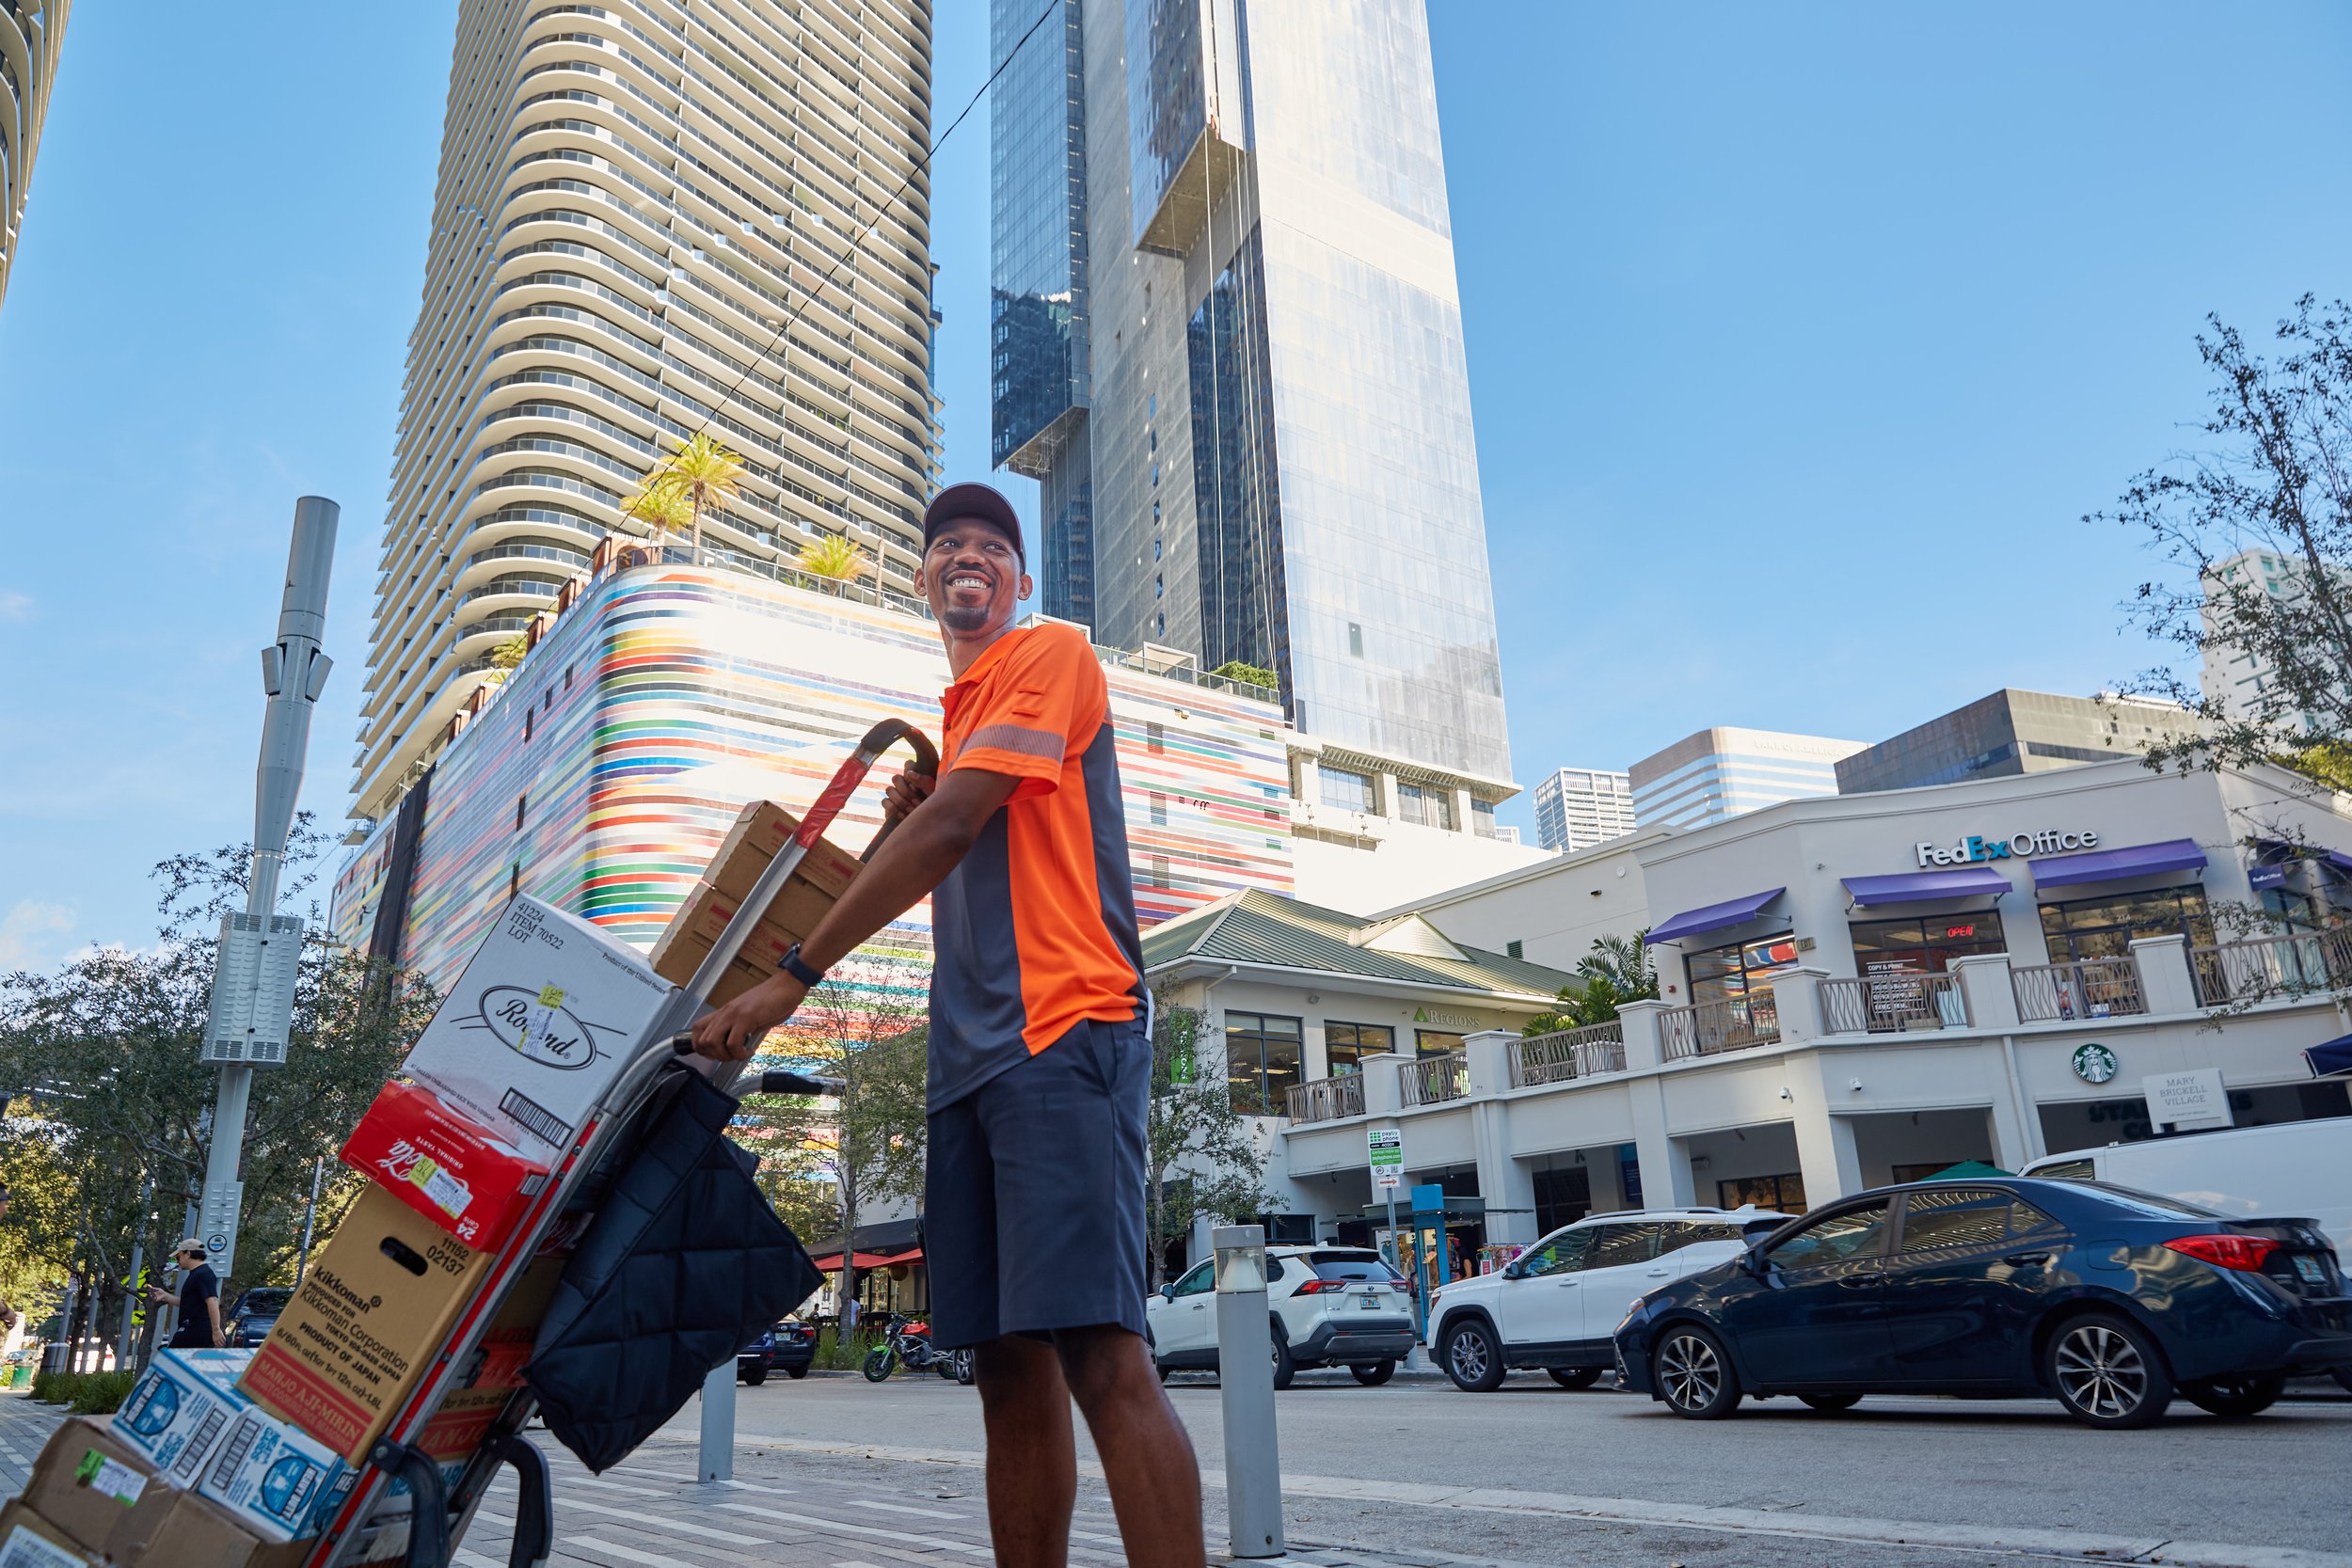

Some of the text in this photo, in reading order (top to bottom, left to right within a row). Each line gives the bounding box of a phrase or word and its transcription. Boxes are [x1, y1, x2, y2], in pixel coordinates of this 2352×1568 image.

[1915, 829, 2098, 867] FedEx Office
[517, 902, 546, 923] 41224
[507, 925, 532, 944] LOT
[510, 911, 564, 950] ITEM 70522
[1947, 926, 1973, 938] OPEN
[496, 999, 579, 1055] Rond
[1430, 1009, 1480, 1027] REGIONS
[2159, 1085, 2208, 1098] BRICKELL
[2167, 1076, 2195, 1087] MARY
[2164, 1095, 2206, 1106] VILLAGE
[413, 1133, 437, 1151] TASTE
[434, 1147, 465, 1169] ORIGINAL
[456, 1223, 477, 1241] 24
[426, 1245, 466, 1276] 02137
[307, 1281, 357, 1319] PRODUCED FOR
[300, 1287, 409, 1373] Kikkoman Corporation
[299, 1322, 381, 1386] PRODUCT OF JAPAN
[326, 1323, 349, 1345] TOKYO
[378, 1361, 403, 1382] JAPAN
[258, 1360, 297, 1390] MANJO
